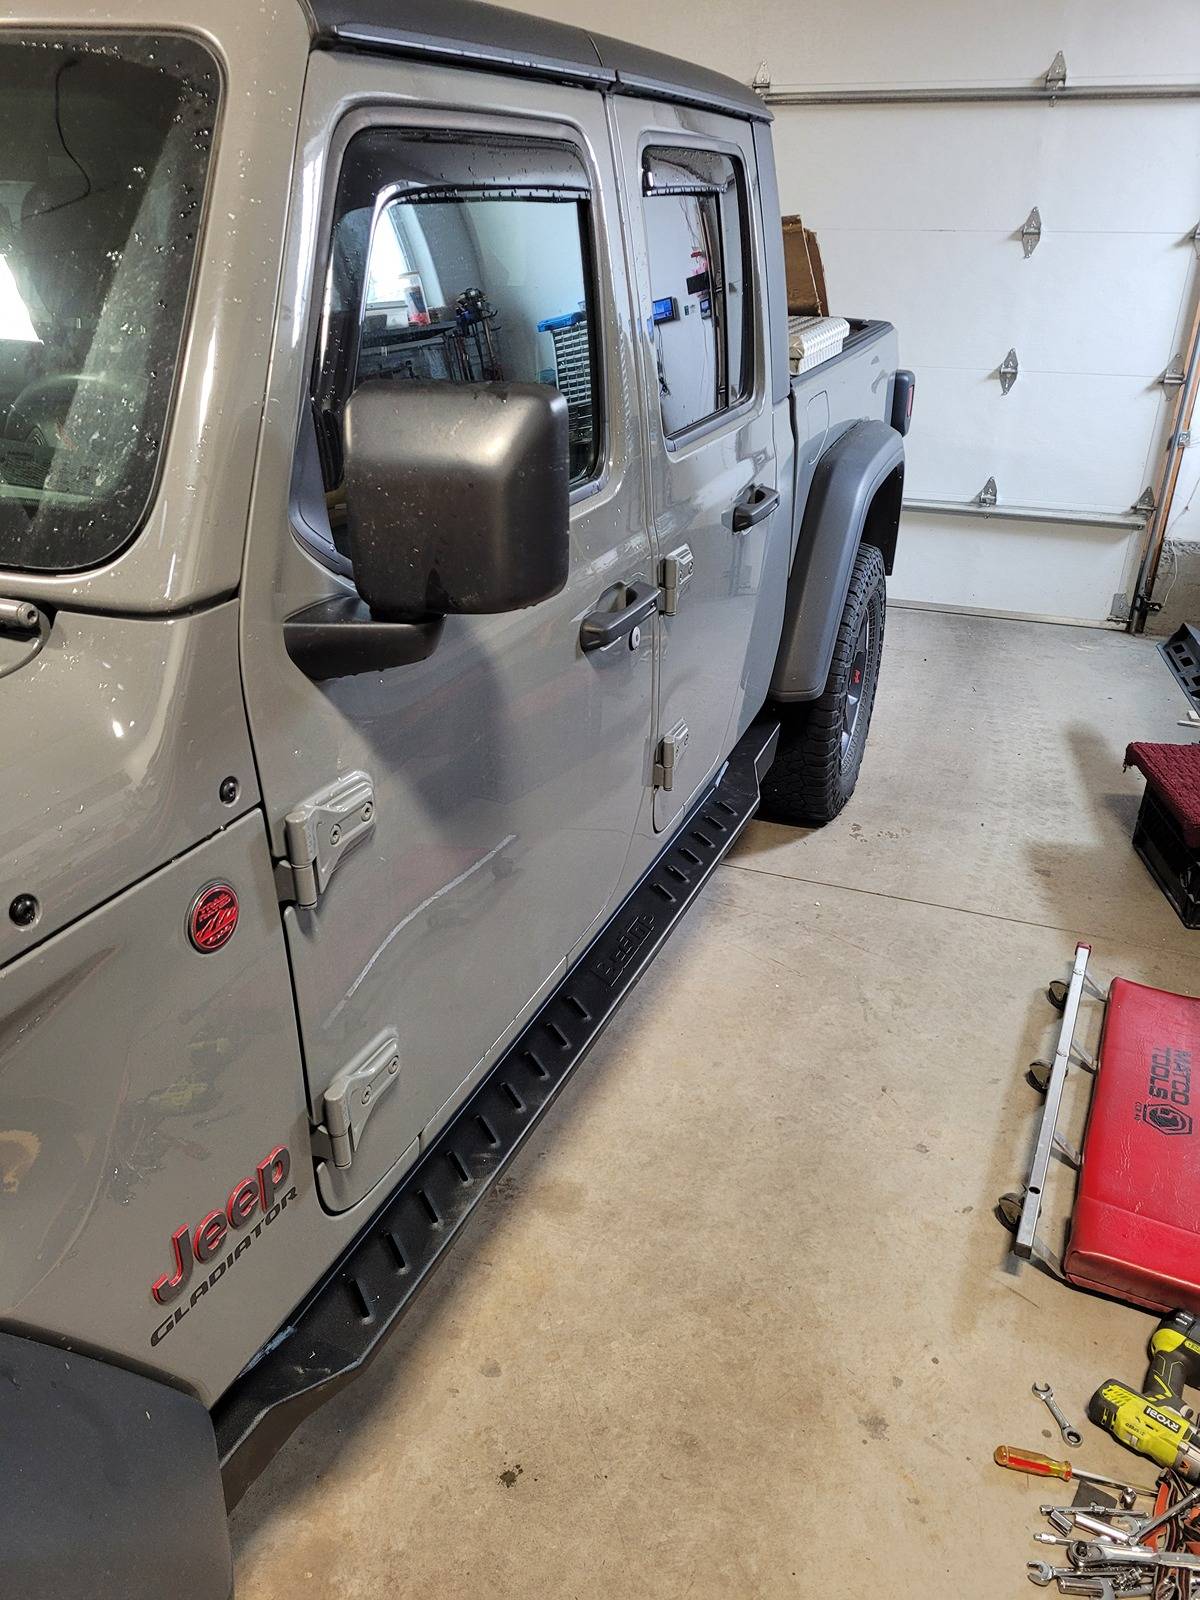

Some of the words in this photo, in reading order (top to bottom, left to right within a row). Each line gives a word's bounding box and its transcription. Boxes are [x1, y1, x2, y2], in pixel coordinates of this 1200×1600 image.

[1149, 1047, 1171, 1100] TOOLS
[1171, 1049, 1191, 1106] MATCO
[151, 1144, 291, 1305] Jeep
[150, 1186, 298, 1347] GLADIATOR
[1145, 1406, 1180, 1432] RYOBI
